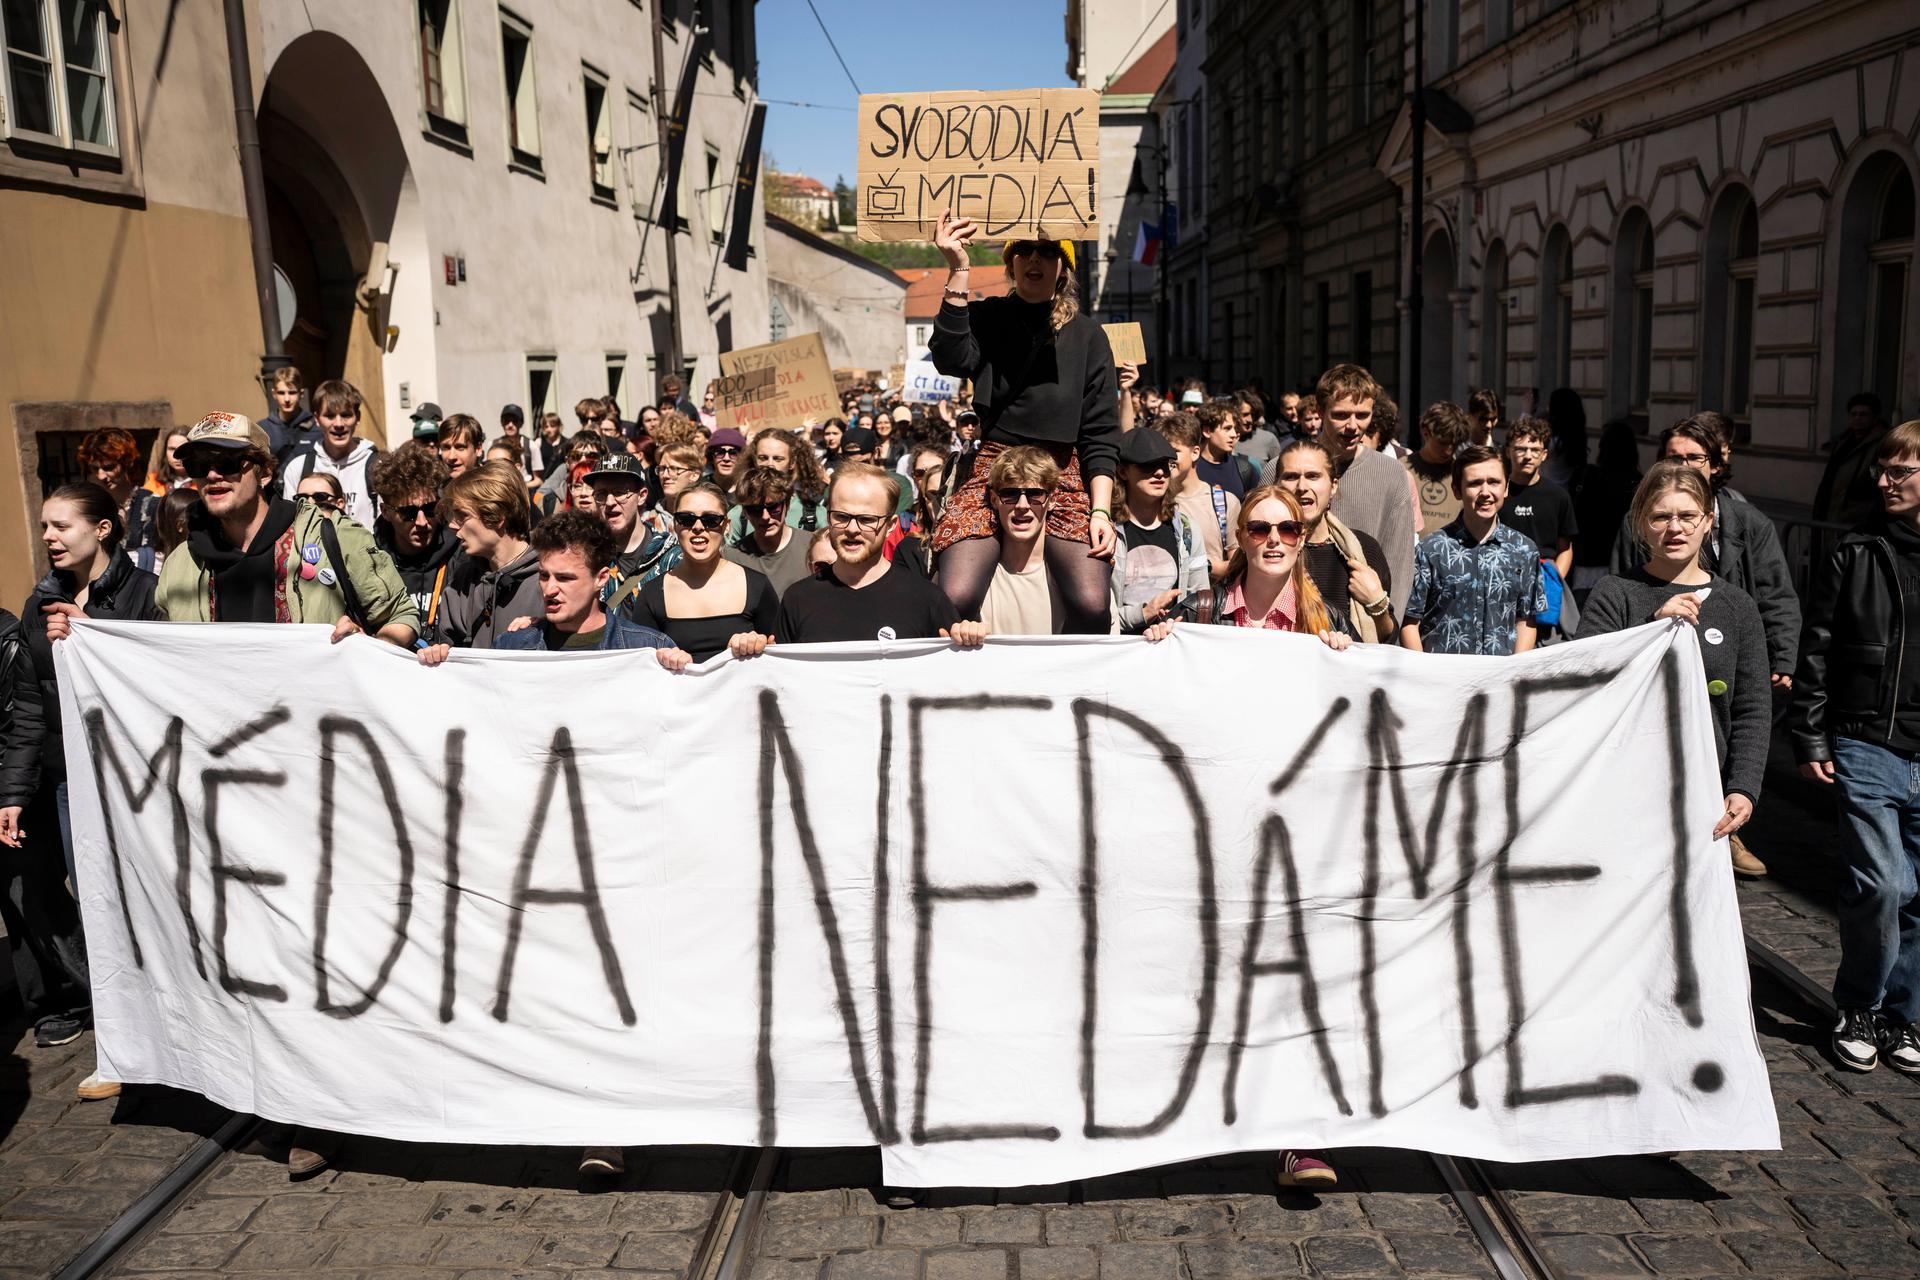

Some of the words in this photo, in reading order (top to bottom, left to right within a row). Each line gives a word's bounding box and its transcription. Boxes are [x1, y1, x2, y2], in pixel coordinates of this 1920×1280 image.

[871, 103, 1085, 164] SVOBODNÁ
[917, 162, 1098, 237] MÉDIA!
[716, 374, 746, 396] KDO
[304, 546, 320, 560] KT!
[84, 704, 638, 1028] MÉDIA
[756, 645, 1726, 1147] NEDÁME!
